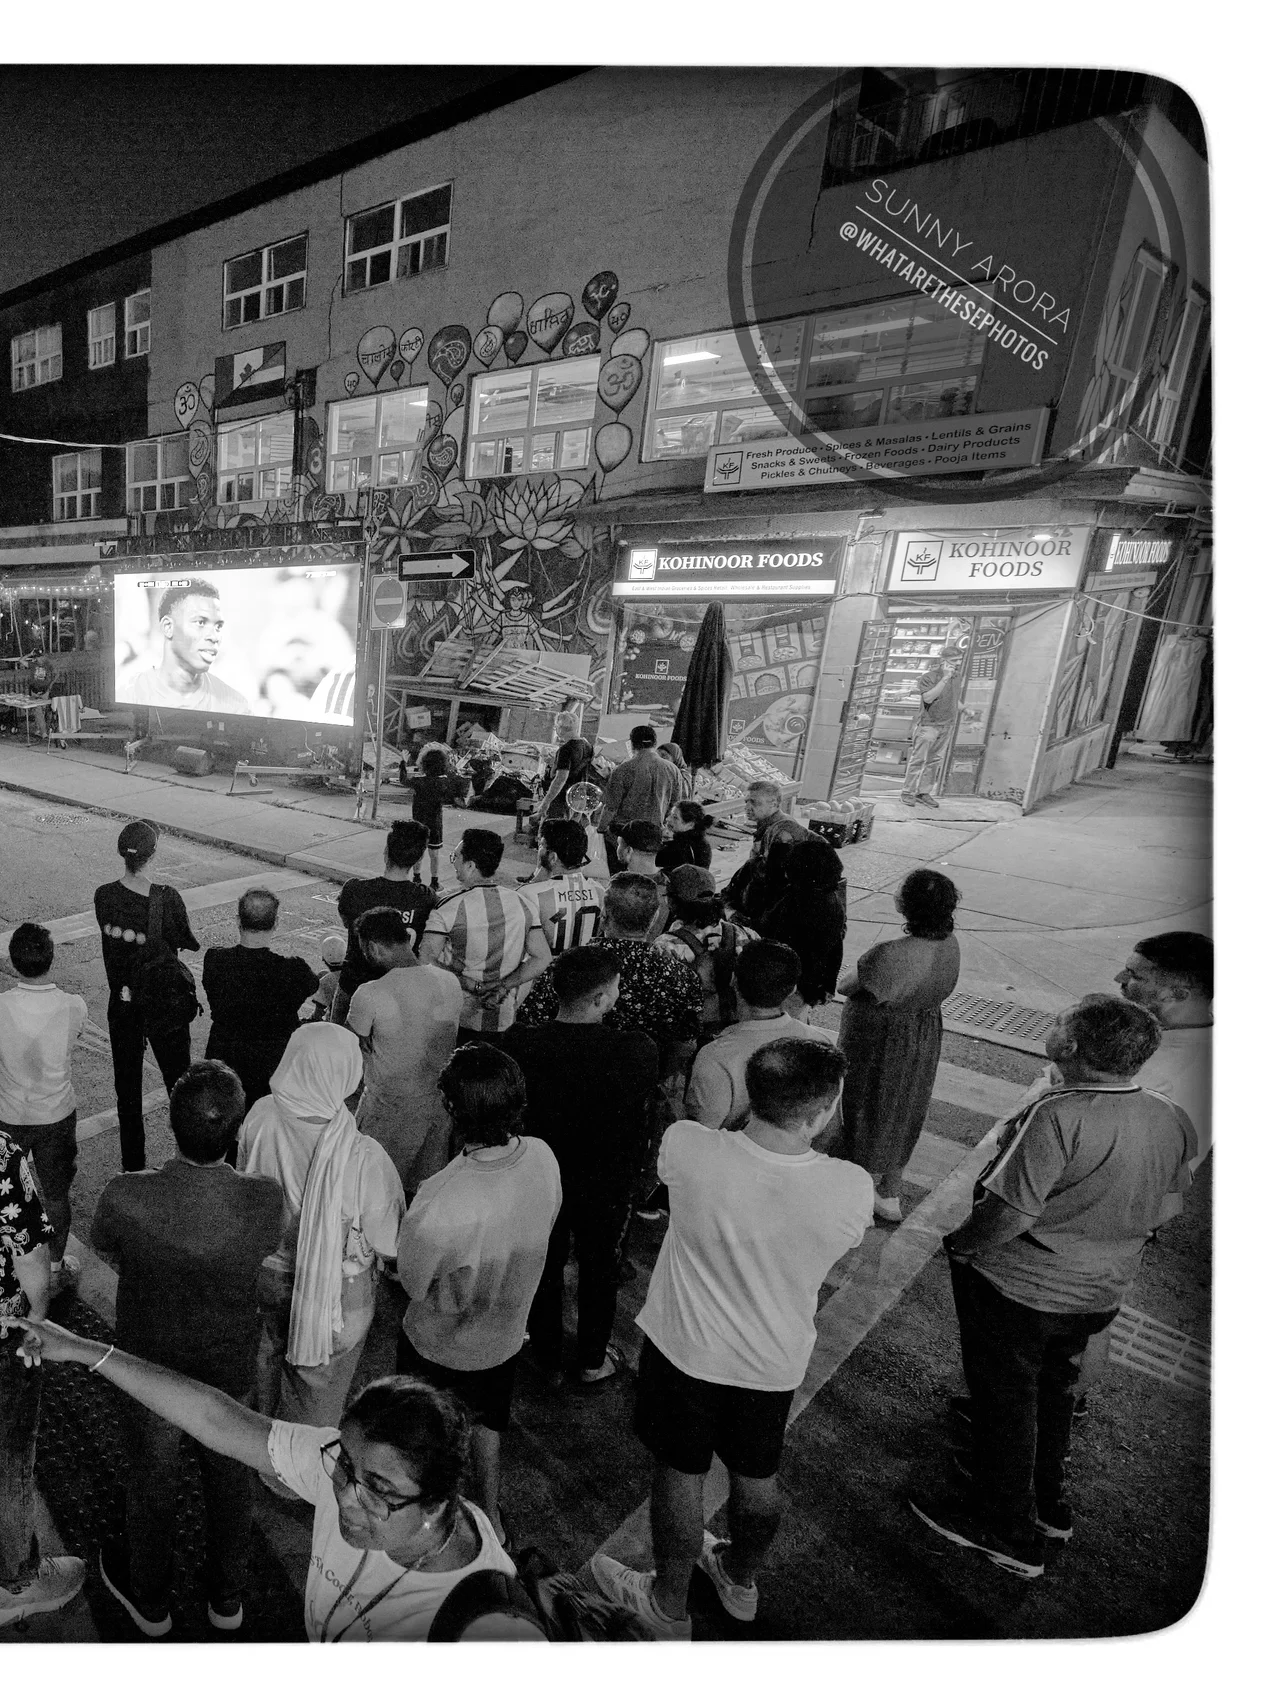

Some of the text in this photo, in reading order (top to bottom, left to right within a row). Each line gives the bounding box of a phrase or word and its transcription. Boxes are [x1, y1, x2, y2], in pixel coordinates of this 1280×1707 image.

[746, 422, 1032, 460] Fresh Produce Spices & Masalas Lentils & Grains
[751, 436, 1021, 471] Snacks & Sweets Frozen Foods Dairy Products
[722, 462, 735, 470] KF
[760, 449, 1007, 480] Pickles & Chutneys Beverages Pooja Items
[915, 553, 931, 562] KF
[949, 540, 1072, 559] KOHINOOR
[658, 552, 824, 570] KOHINOOR FOODS
[969, 561, 1044, 578] FOODS
[958, 633, 1002, 649] OEN
[635, 673, 667, 681] KOHINOOR
[558, 889, 594, 902] MESSI
[549, 905, 602, 955] 10
